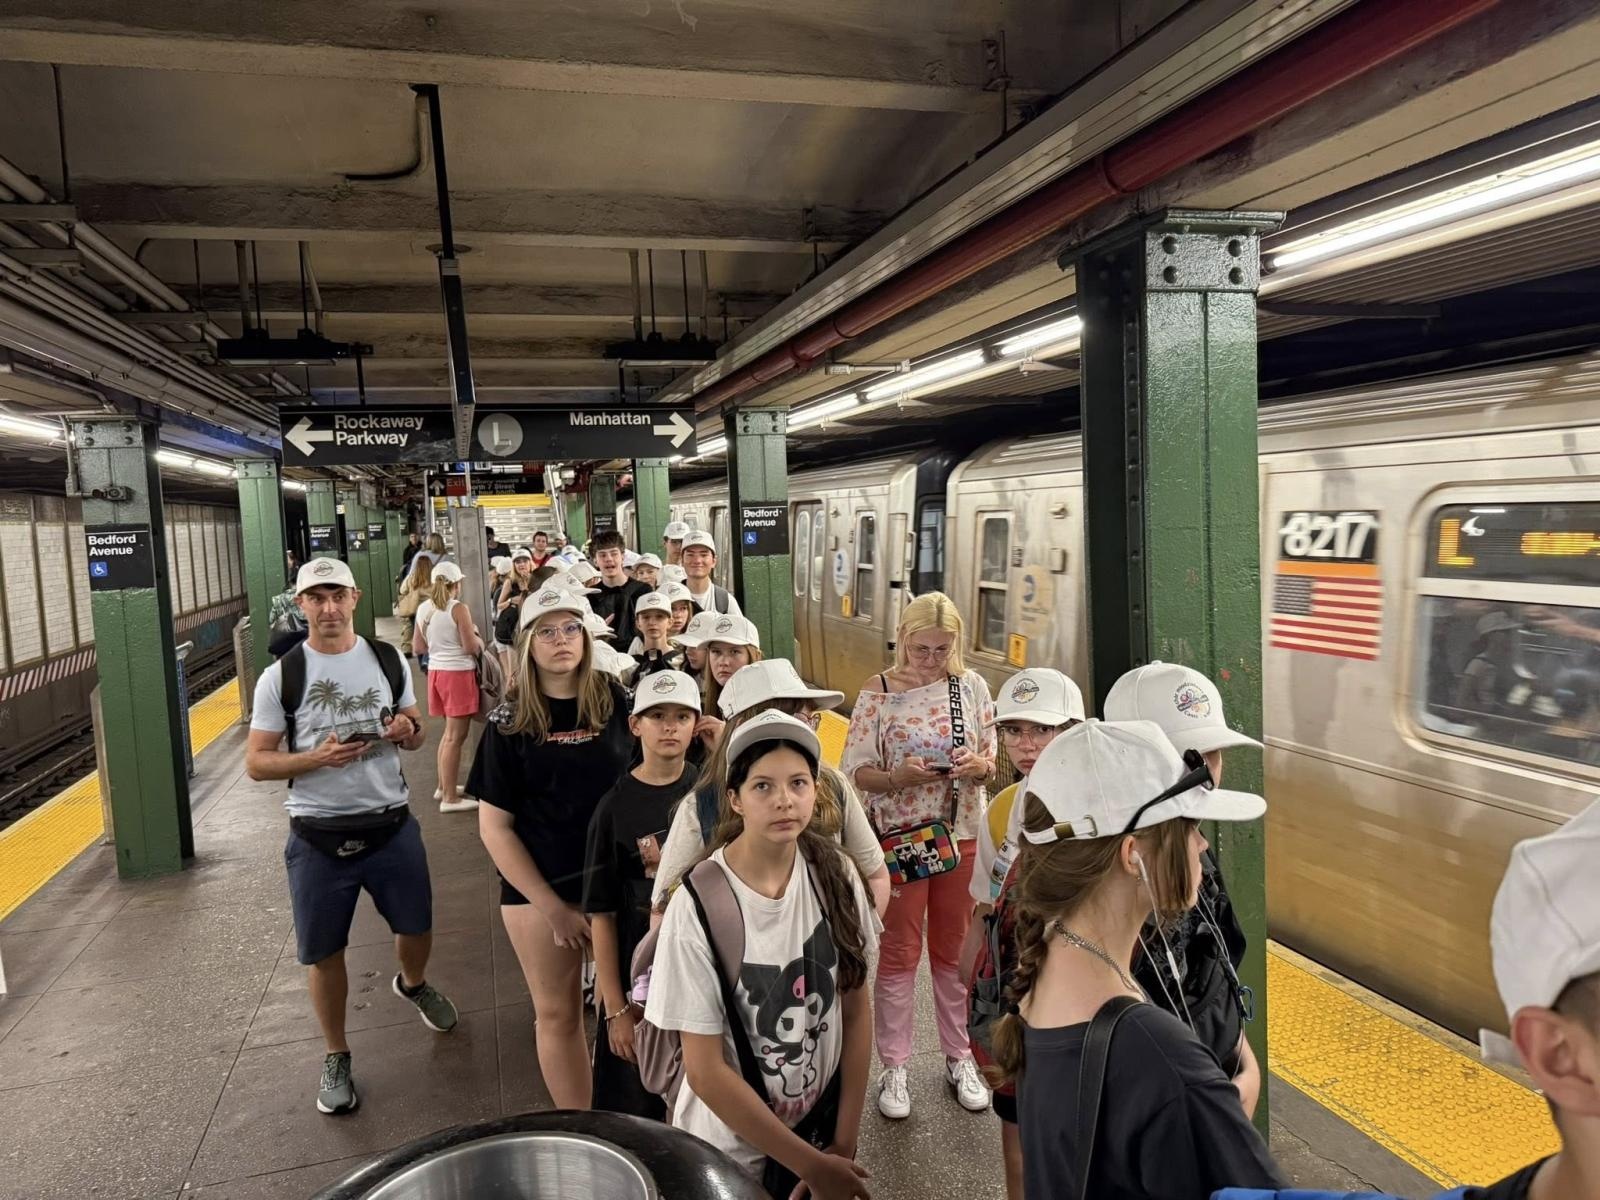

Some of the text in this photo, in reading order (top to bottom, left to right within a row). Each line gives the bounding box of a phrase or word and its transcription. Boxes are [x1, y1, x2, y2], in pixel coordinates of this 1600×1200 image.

[334, 414, 424, 430] Rockaway
[569, 412, 651, 426] Manhattan
[336, 431, 408, 447] Parkway
[492, 422, 512, 446] L
[744, 509, 779, 518] Bedford
[744, 519, 776, 527] Avenue
[88, 534, 137, 546] Bedford
[1281, 512, 1377, 558] 8217
[1438, 519, 1475, 565] L
[89, 546, 134, 557] Avenue
